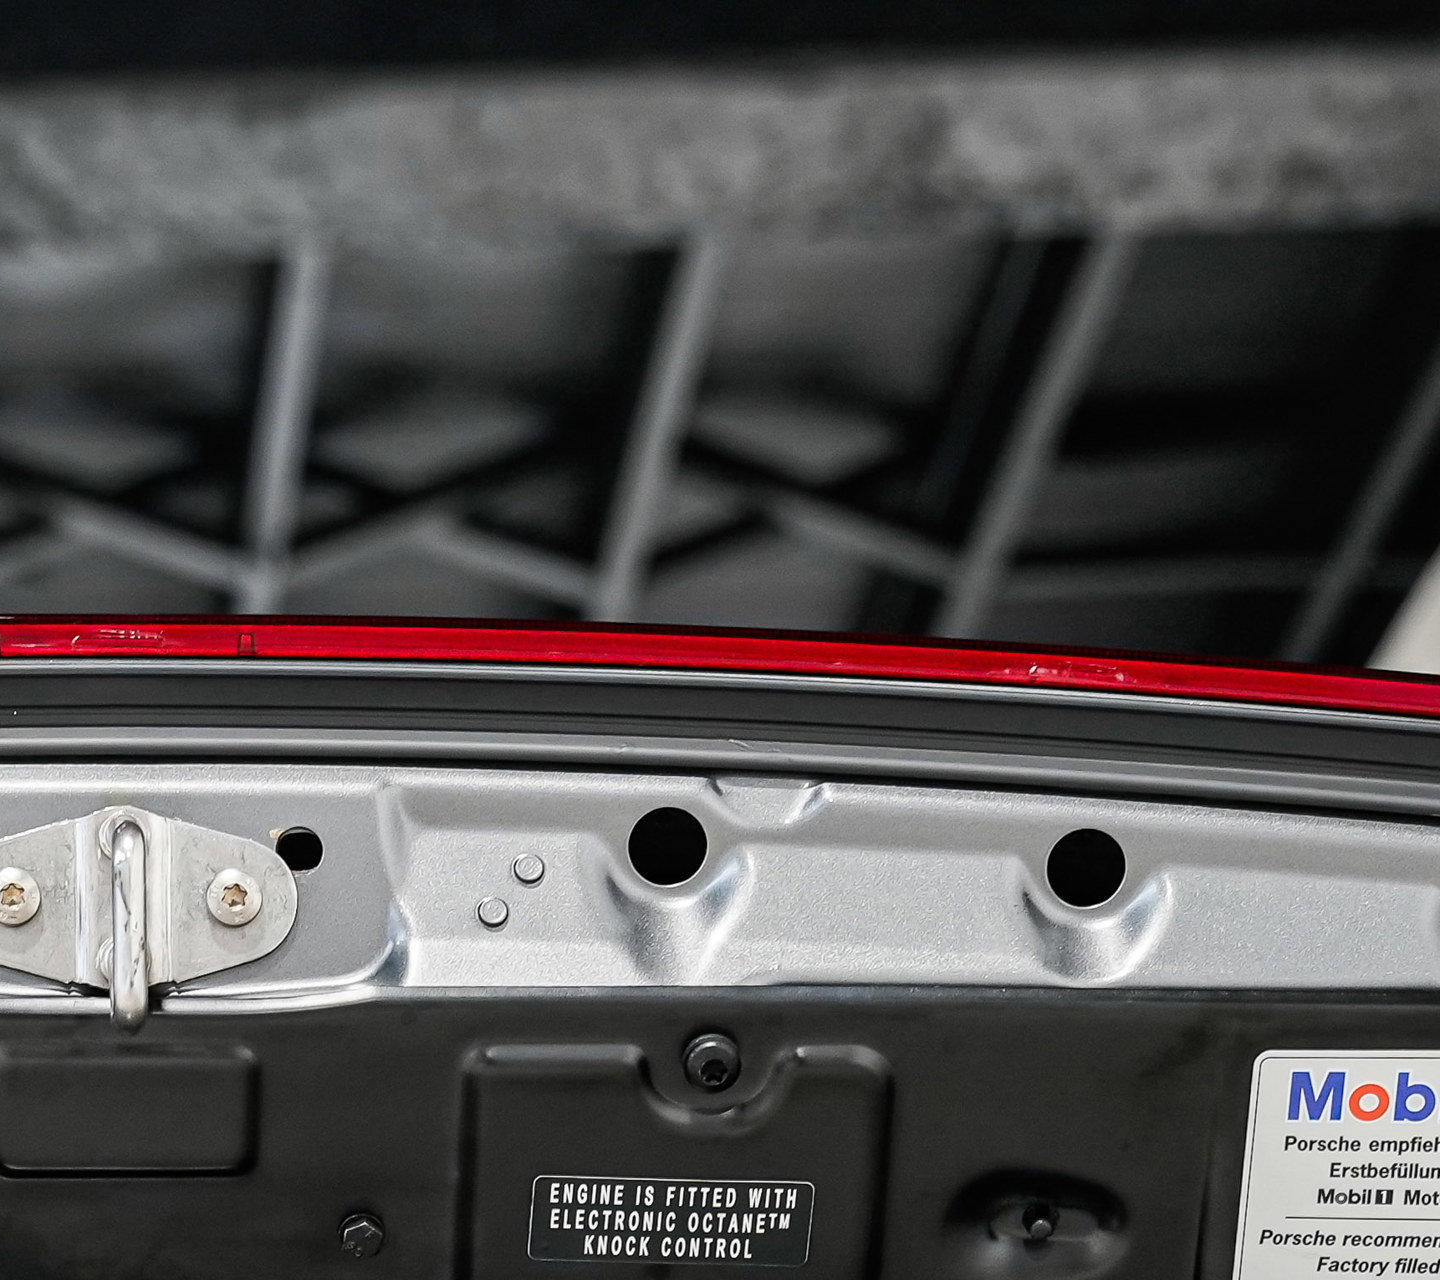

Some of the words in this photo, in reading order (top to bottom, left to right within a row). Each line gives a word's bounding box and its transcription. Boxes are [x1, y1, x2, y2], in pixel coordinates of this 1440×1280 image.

[1284, 1135, 1361, 1152] Porsche
[549, 1182, 625, 1206] ENGINE
[635, 1185, 655, 1207] IS
[665, 1186, 737, 1208] FITTED
[748, 1187, 798, 1210] WITH
[1317, 1188, 1372, 1205] Mobil
[550, 1208, 677, 1232] ELECTRONIC
[583, 1234, 651, 1257] KNOCK
[661, 1237, 752, 1259] CONTROL
[1259, 1229, 1337, 1246] Porsche
[1316, 1256, 1390, 1277] Factory
